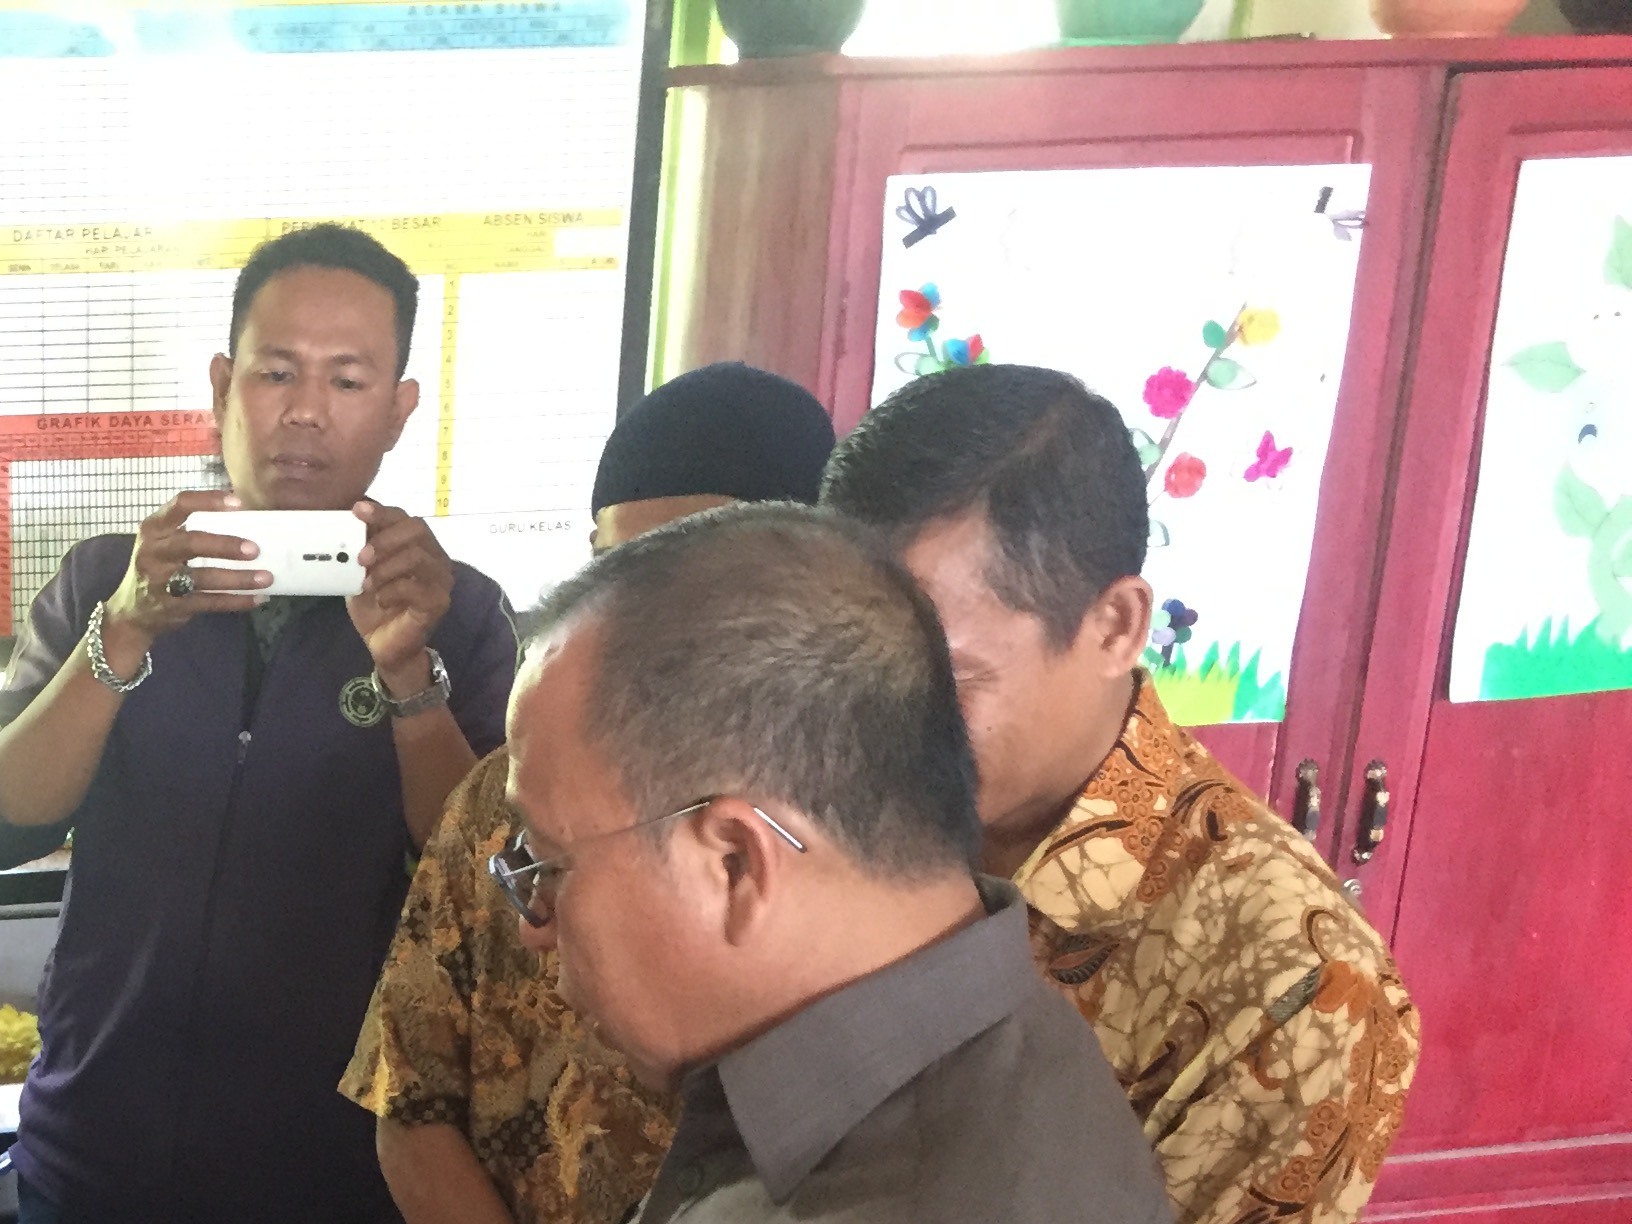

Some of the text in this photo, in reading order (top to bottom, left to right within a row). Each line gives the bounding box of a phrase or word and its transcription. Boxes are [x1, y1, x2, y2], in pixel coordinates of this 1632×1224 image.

[391, 216, 442, 231] BESAR
[483, 211, 585, 227] ABSEN SISWA
[13, 228, 75, 243] DAFTAR
[36, 416, 102, 431] GRAFIK
[109, 415, 154, 429] DAYA
[436, 497, 450, 509] 10
[489, 520, 572, 534] GURU KELAS
